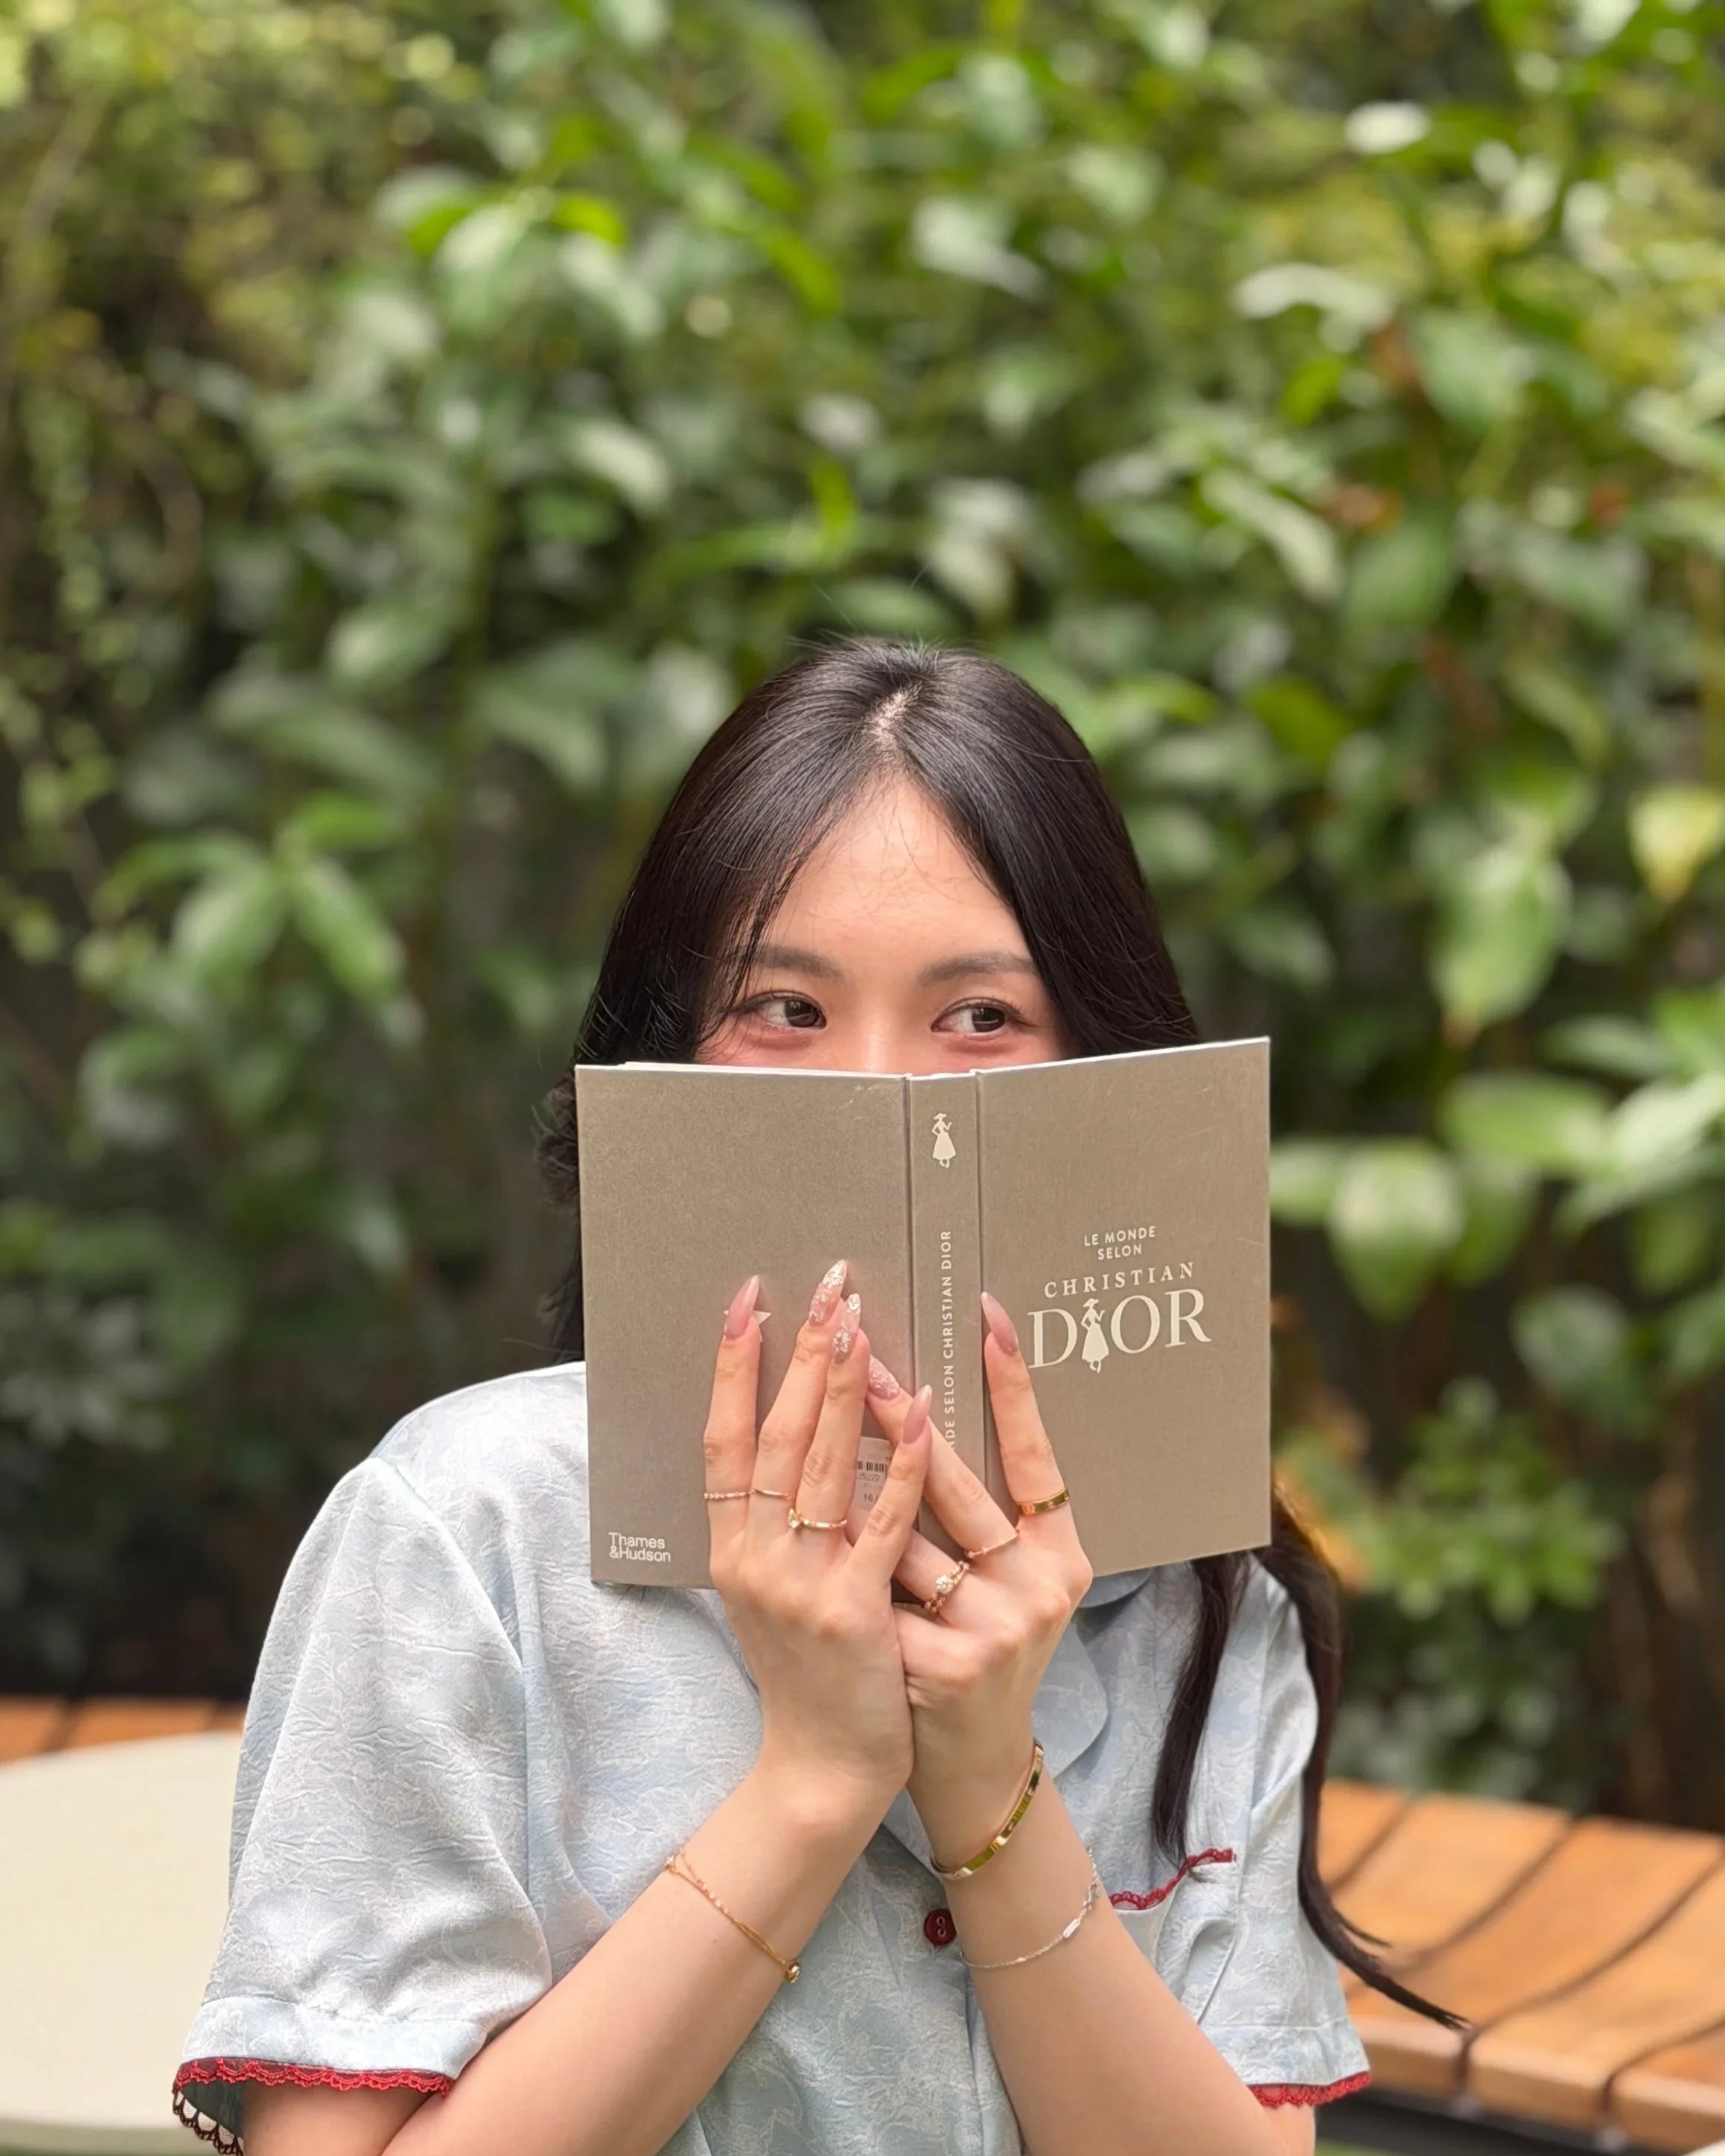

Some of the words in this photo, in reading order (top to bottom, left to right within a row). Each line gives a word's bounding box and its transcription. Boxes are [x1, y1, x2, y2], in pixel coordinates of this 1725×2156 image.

[940, 1230, 952, 1270] DIOR
[1084, 1233, 1099, 1247] LE
[1104, 1225, 1156, 1244] MONDE
[1097, 1243, 1142, 1260] SELON
[1044, 1261, 1194, 1298] CHRISTIAN
[941, 1275, 954, 1359] CHRISTIAN
[943, 1365, 955, 1414] SELON
[608, 1531, 666, 1549] Thames
[609, 1545, 672, 1563] &Hudson
